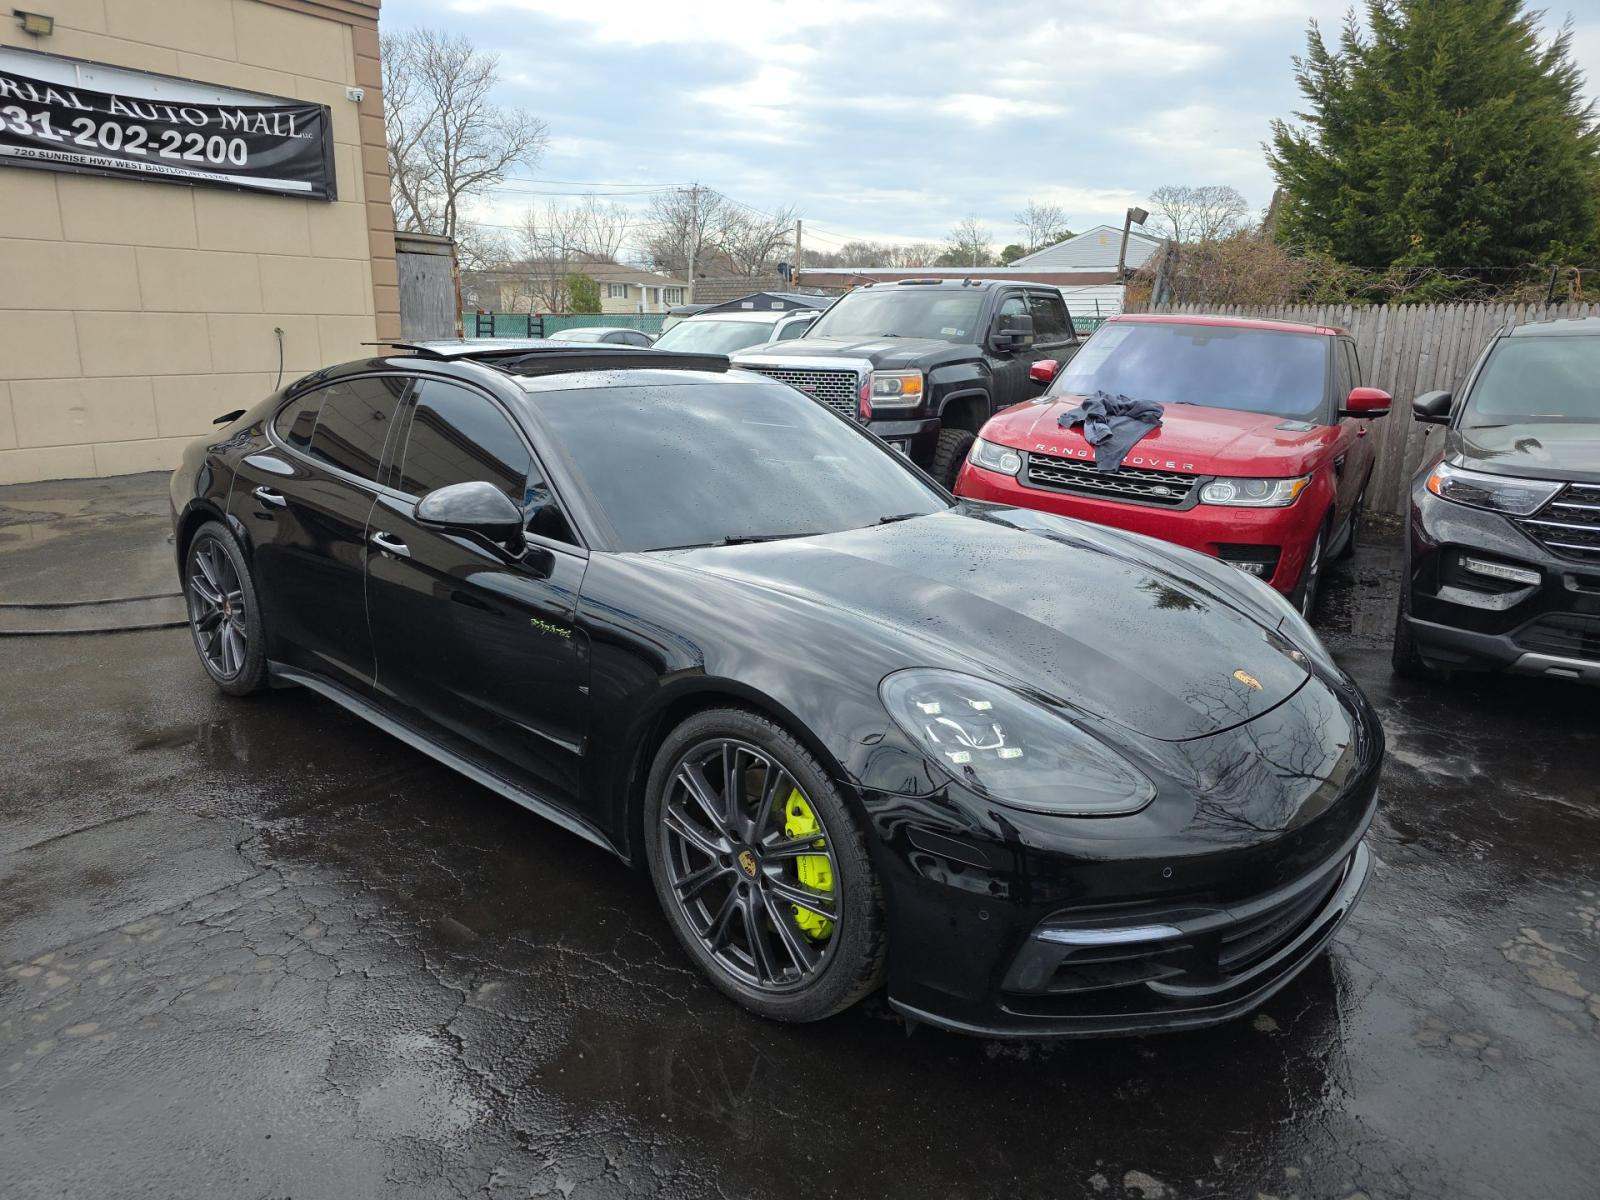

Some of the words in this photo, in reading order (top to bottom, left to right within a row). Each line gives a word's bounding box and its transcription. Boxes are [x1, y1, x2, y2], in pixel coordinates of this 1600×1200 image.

[0, 105, 248, 166] 31-202-2200
[110, 94, 208, 127] AUTO
[217, 107, 302, 138] MALL
[14, 148, 36, 157] 720
[39, 151, 86, 163] SUNRISE
[89, 157, 112, 167] HWY
[115, 160, 143, 171] WEST
